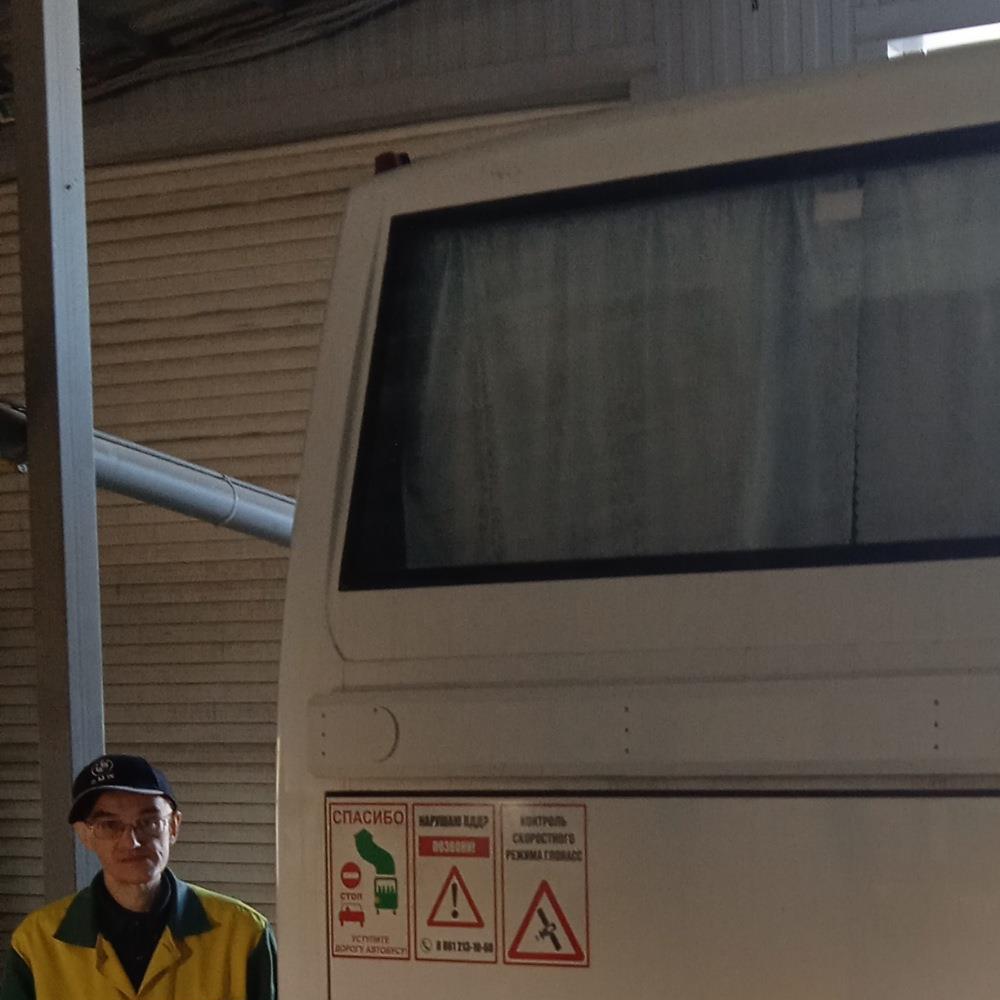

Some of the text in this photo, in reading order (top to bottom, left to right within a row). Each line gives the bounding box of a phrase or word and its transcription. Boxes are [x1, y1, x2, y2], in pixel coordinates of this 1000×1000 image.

[332, 810, 405, 825] СПАСИБО
[512, 832, 576, 845] СКОРОСТНОГО
[340, 892, 363, 900] СТОП
[351, 935, 390, 944] УСТУПИТЕ
[335, 944, 364, 953] ДОРОГУ
